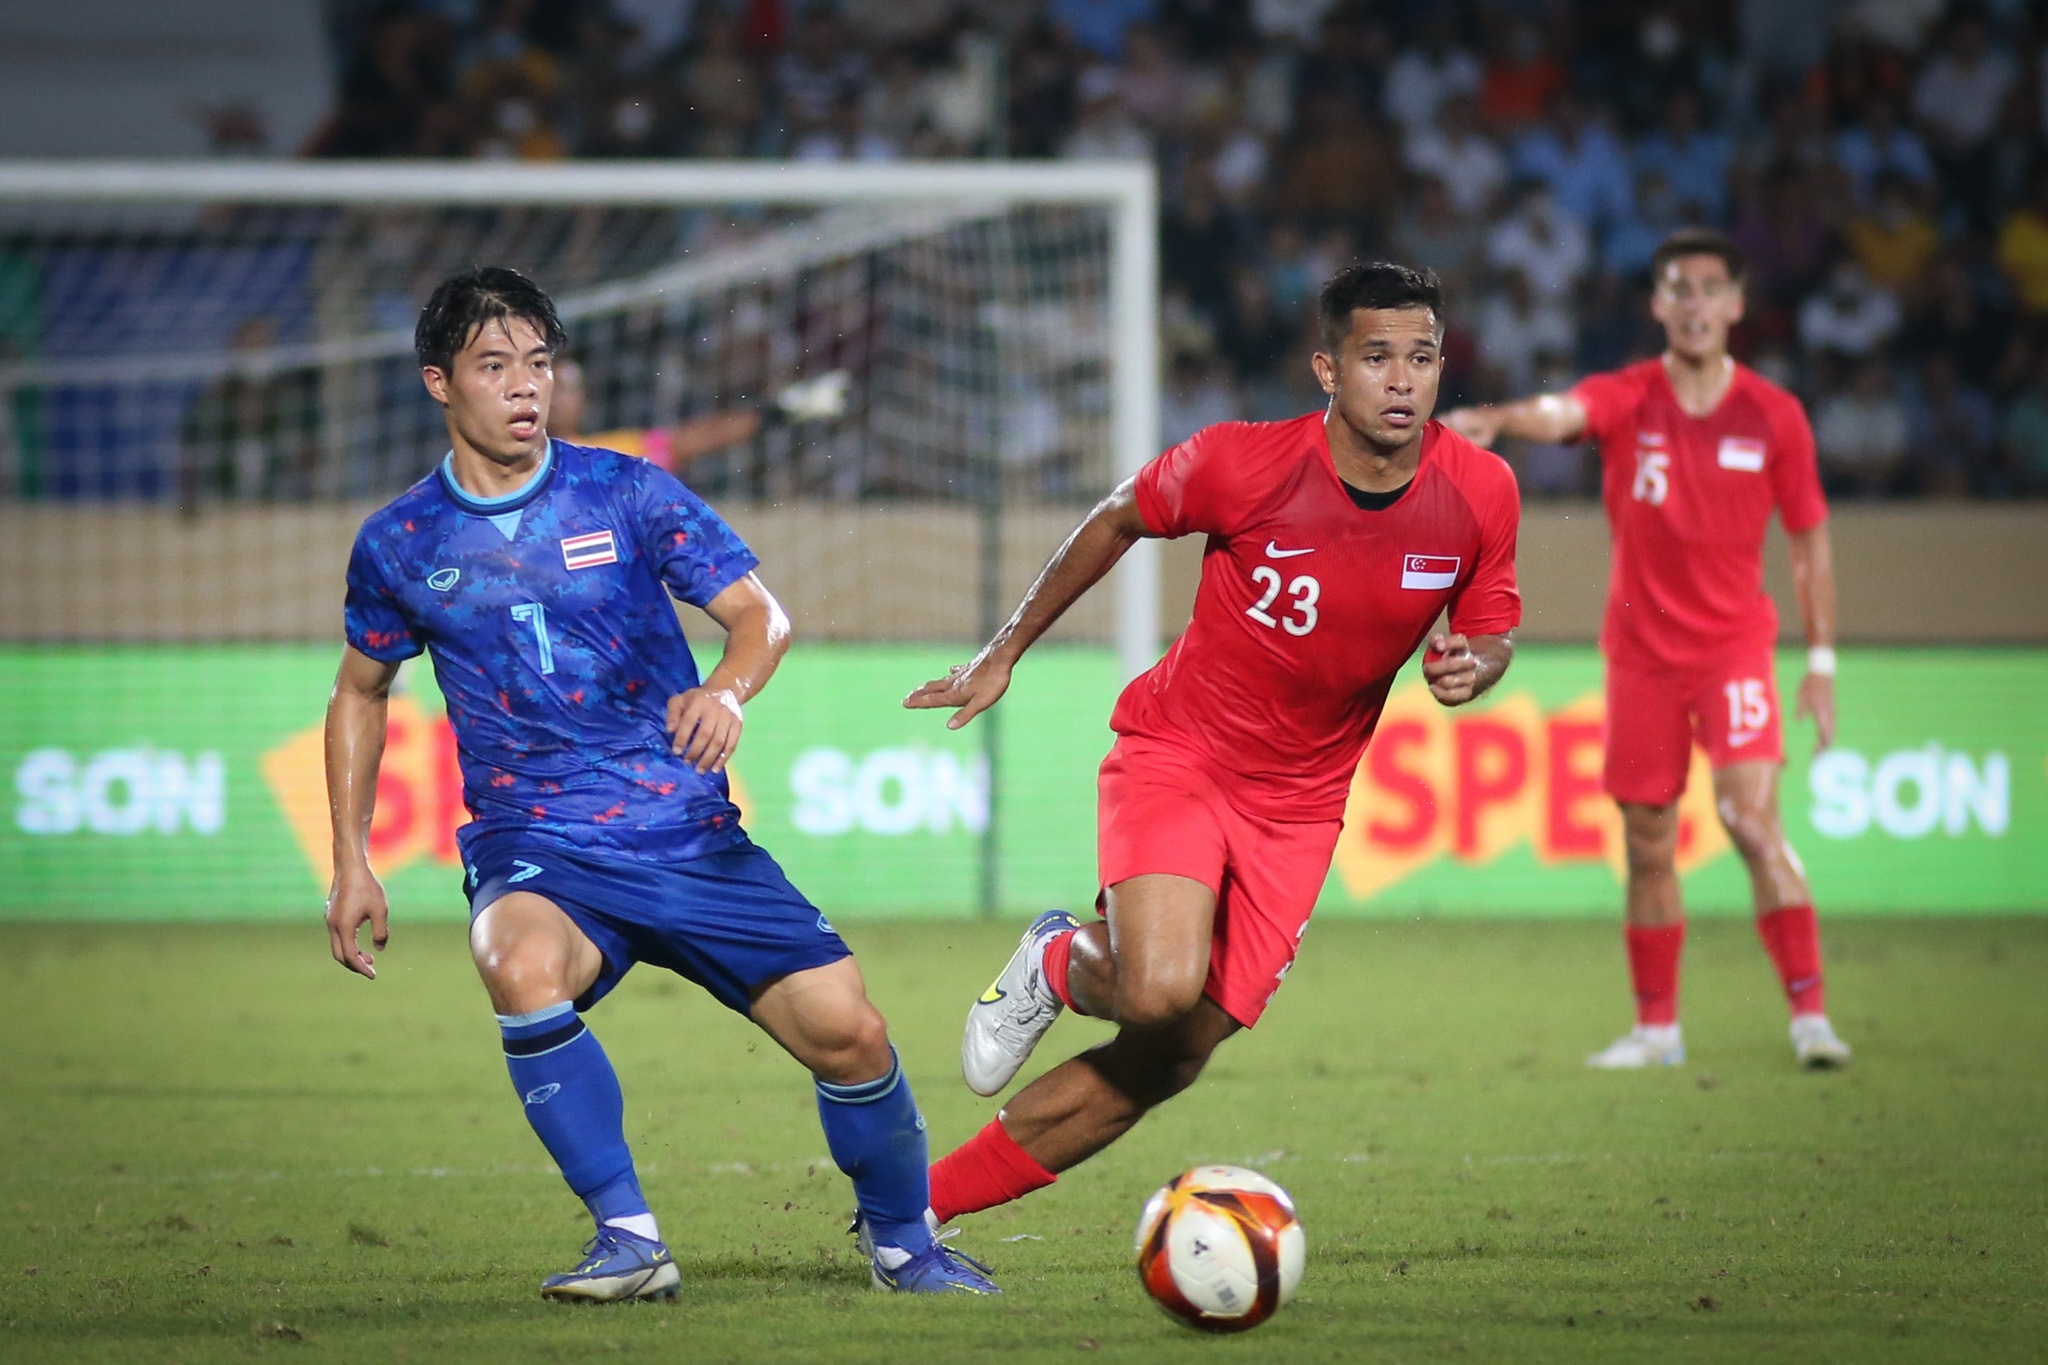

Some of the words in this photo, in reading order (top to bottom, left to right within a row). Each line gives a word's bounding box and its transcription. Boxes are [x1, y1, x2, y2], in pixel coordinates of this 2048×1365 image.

[1632, 450, 1670, 506] 15
[1246, 565, 1321, 636] 23
[510, 602, 556, 675] 7
[1724, 677, 1770, 728] 15
[1365, 717, 1695, 860] SPE
[507, 859, 545, 883] 7
